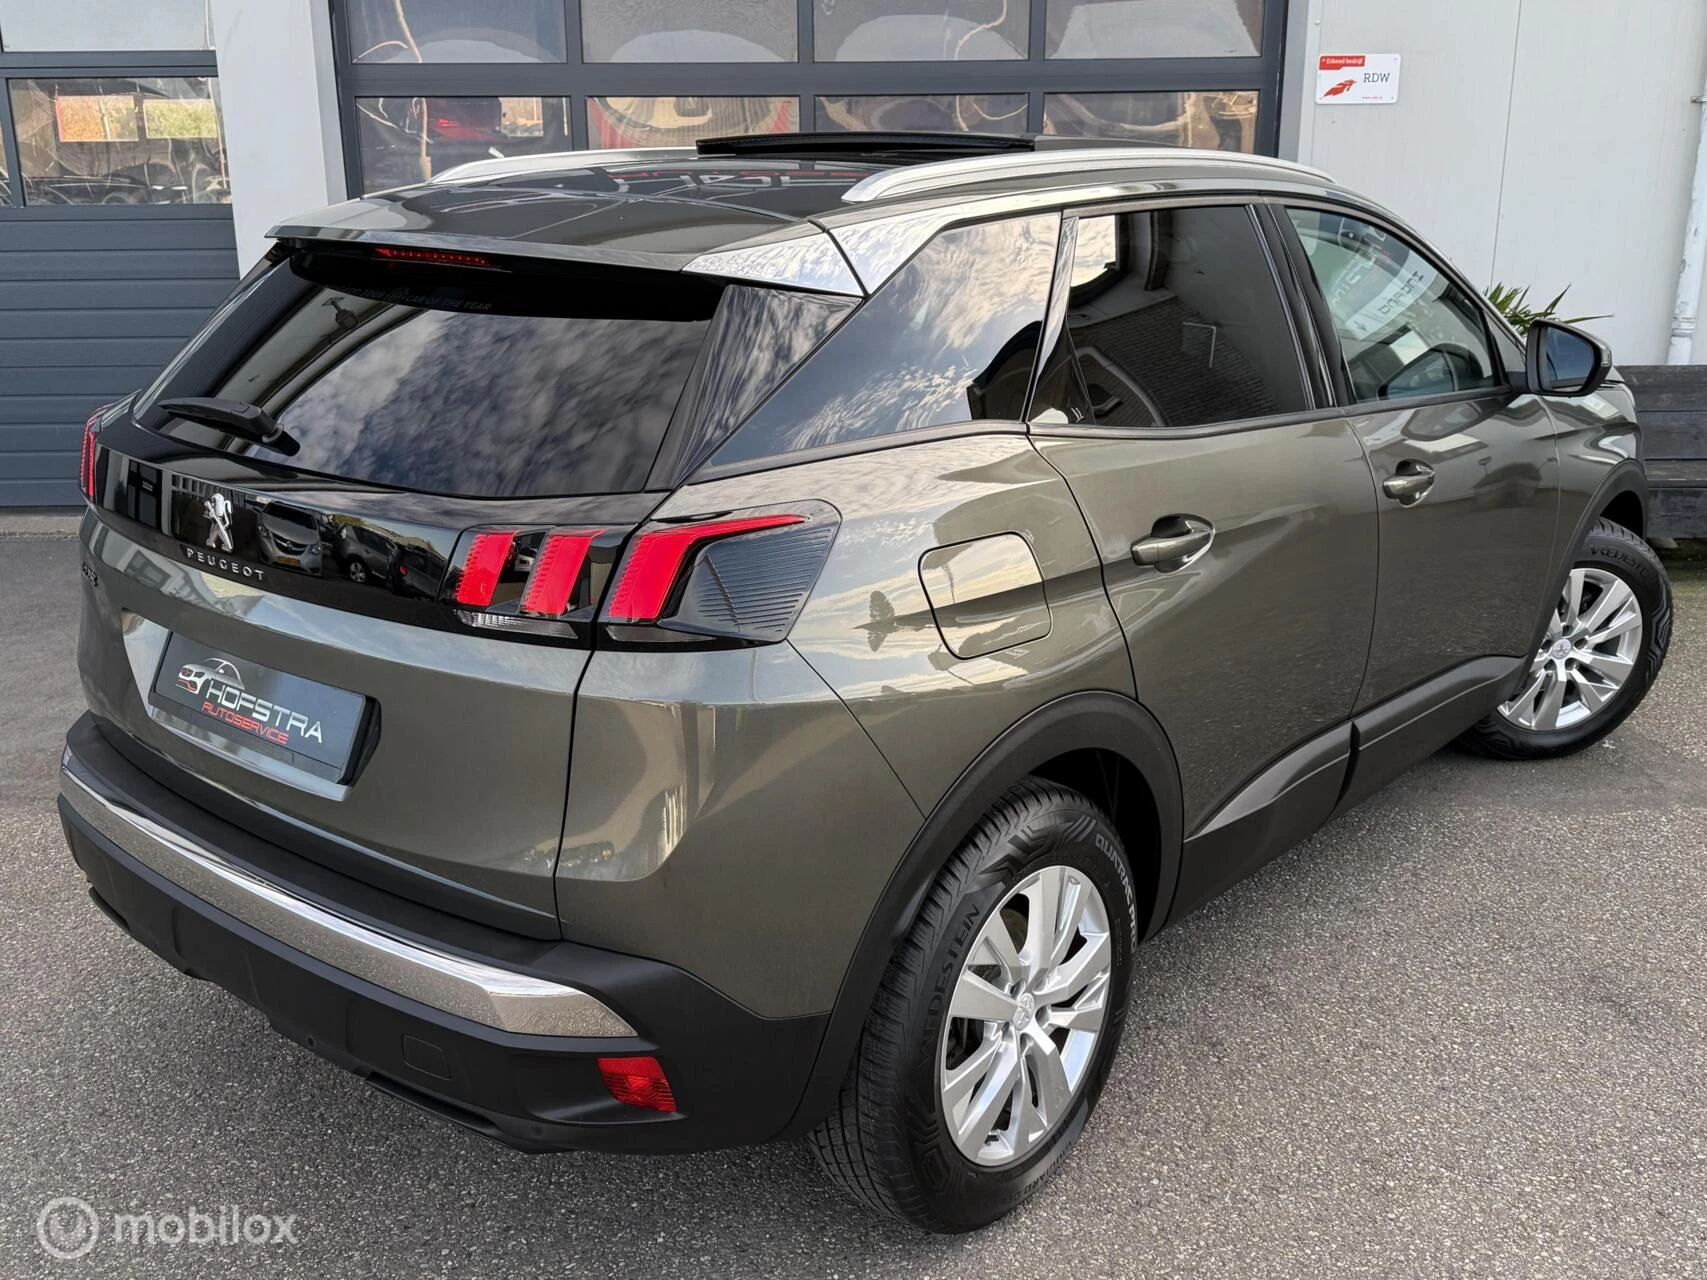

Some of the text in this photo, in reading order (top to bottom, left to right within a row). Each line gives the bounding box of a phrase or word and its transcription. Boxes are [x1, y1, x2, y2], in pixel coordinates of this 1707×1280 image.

[1363, 73, 1391, 83] RDW
[186, 547, 265, 581] PEUGEOT
[201, 701, 289, 744] AUTOSERVICE
[206, 680, 322, 743] HOFSTRA
[1095, 833, 1133, 905] QUATRAC
